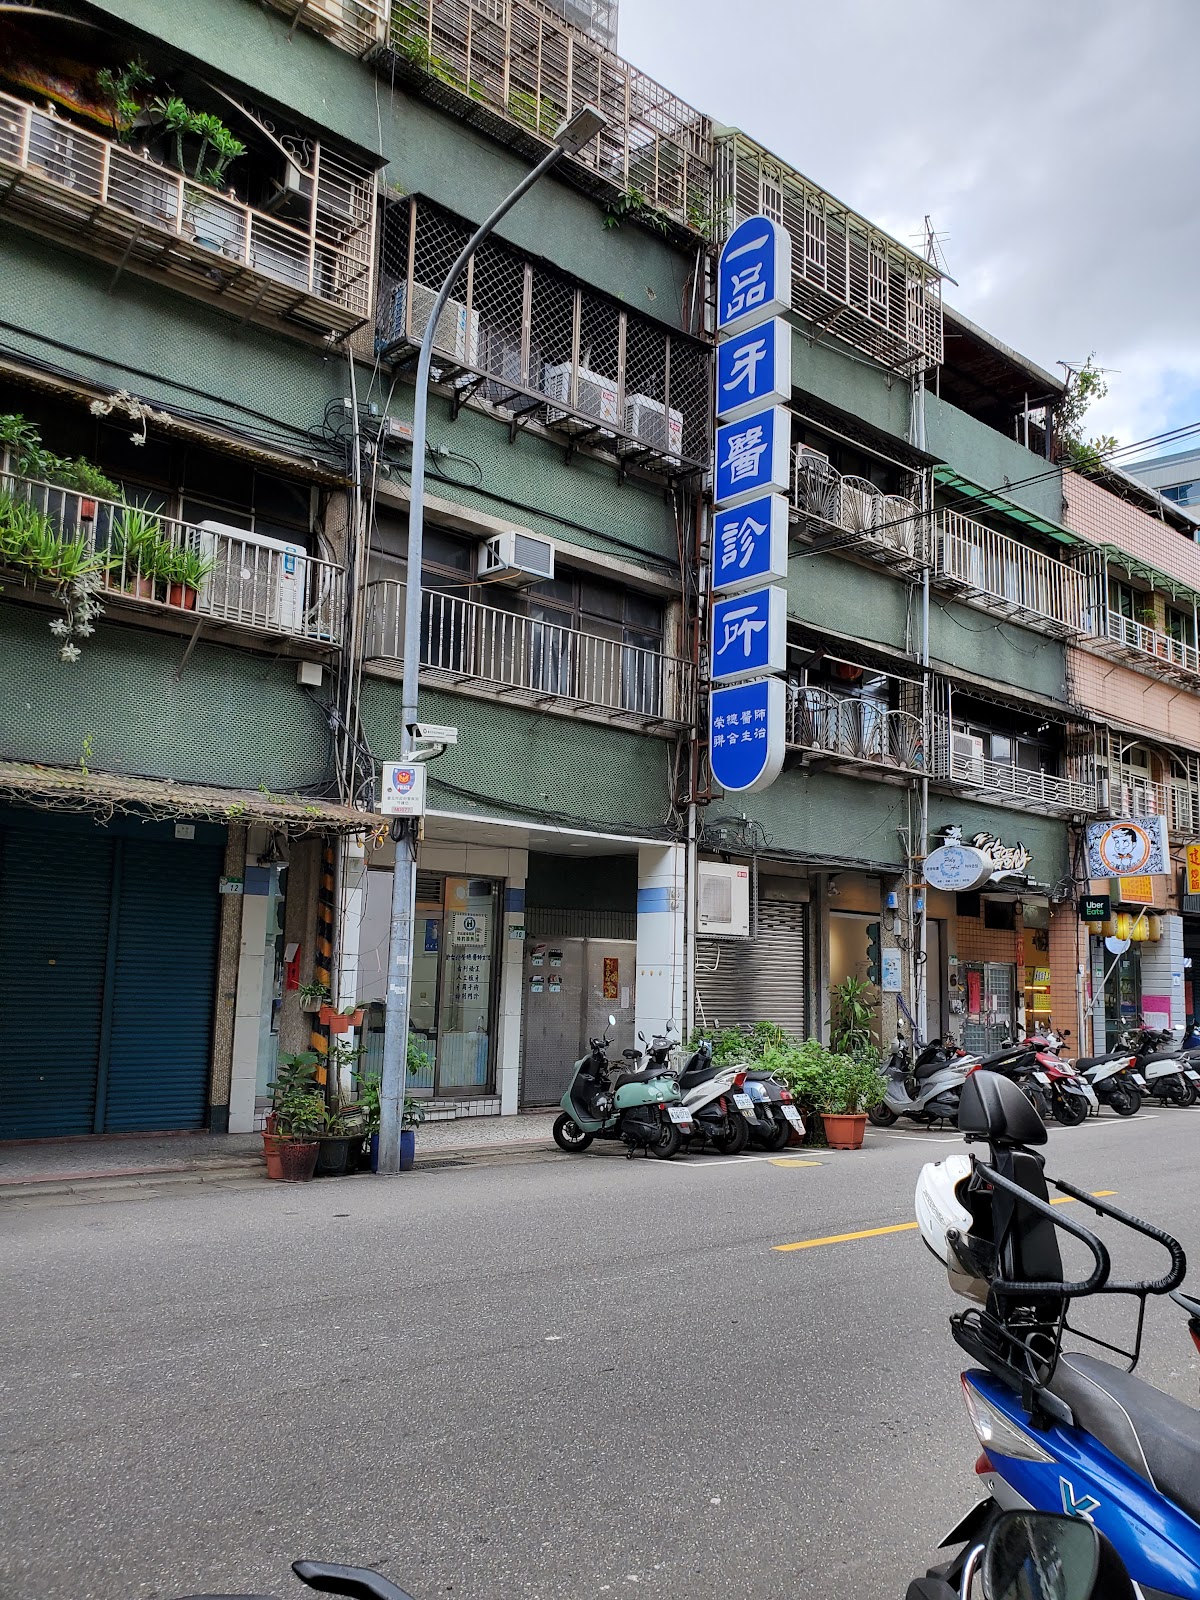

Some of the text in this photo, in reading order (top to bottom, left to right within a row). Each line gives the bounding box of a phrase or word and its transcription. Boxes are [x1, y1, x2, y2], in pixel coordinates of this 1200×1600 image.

[717, 233, 770, 657] 一品牙醫診所
[713, 708, 767, 730] 榮總醫師
[713, 727, 767, 748] 聯合主治
[1086, 901, 1104, 909] Uber
